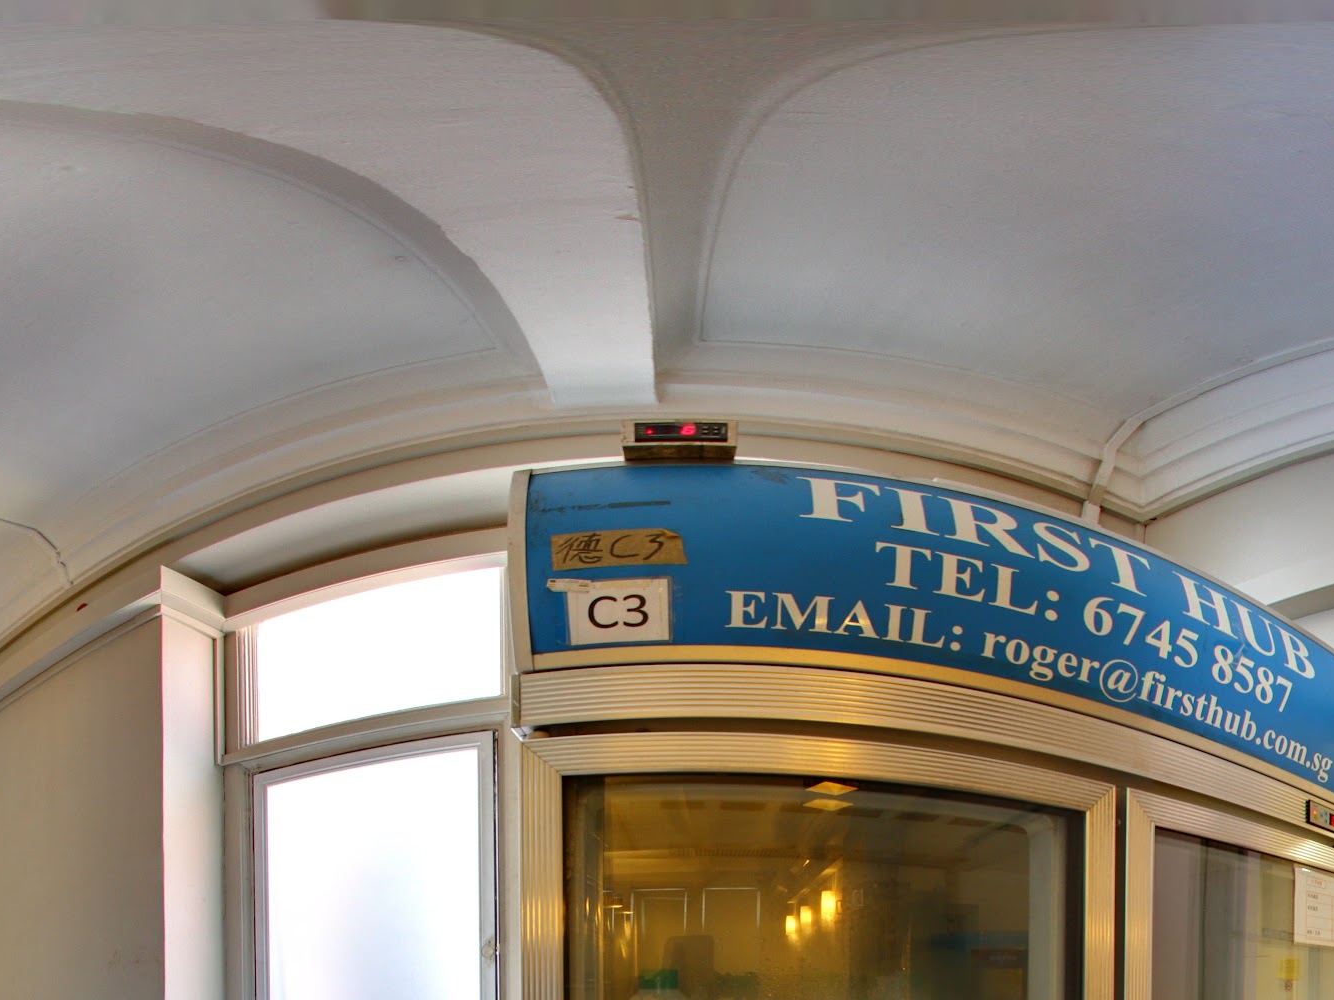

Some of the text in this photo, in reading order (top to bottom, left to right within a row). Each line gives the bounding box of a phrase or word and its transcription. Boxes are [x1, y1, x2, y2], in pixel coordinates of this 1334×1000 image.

[587, 594, 649, 629] C3
[796, 476, 1315, 679] FIRST HUB
[875, 541, 1293, 713] TEL: 6745 8587
[724, 590, 1333, 783] EMAIL: roger@firsthub.com.sg
